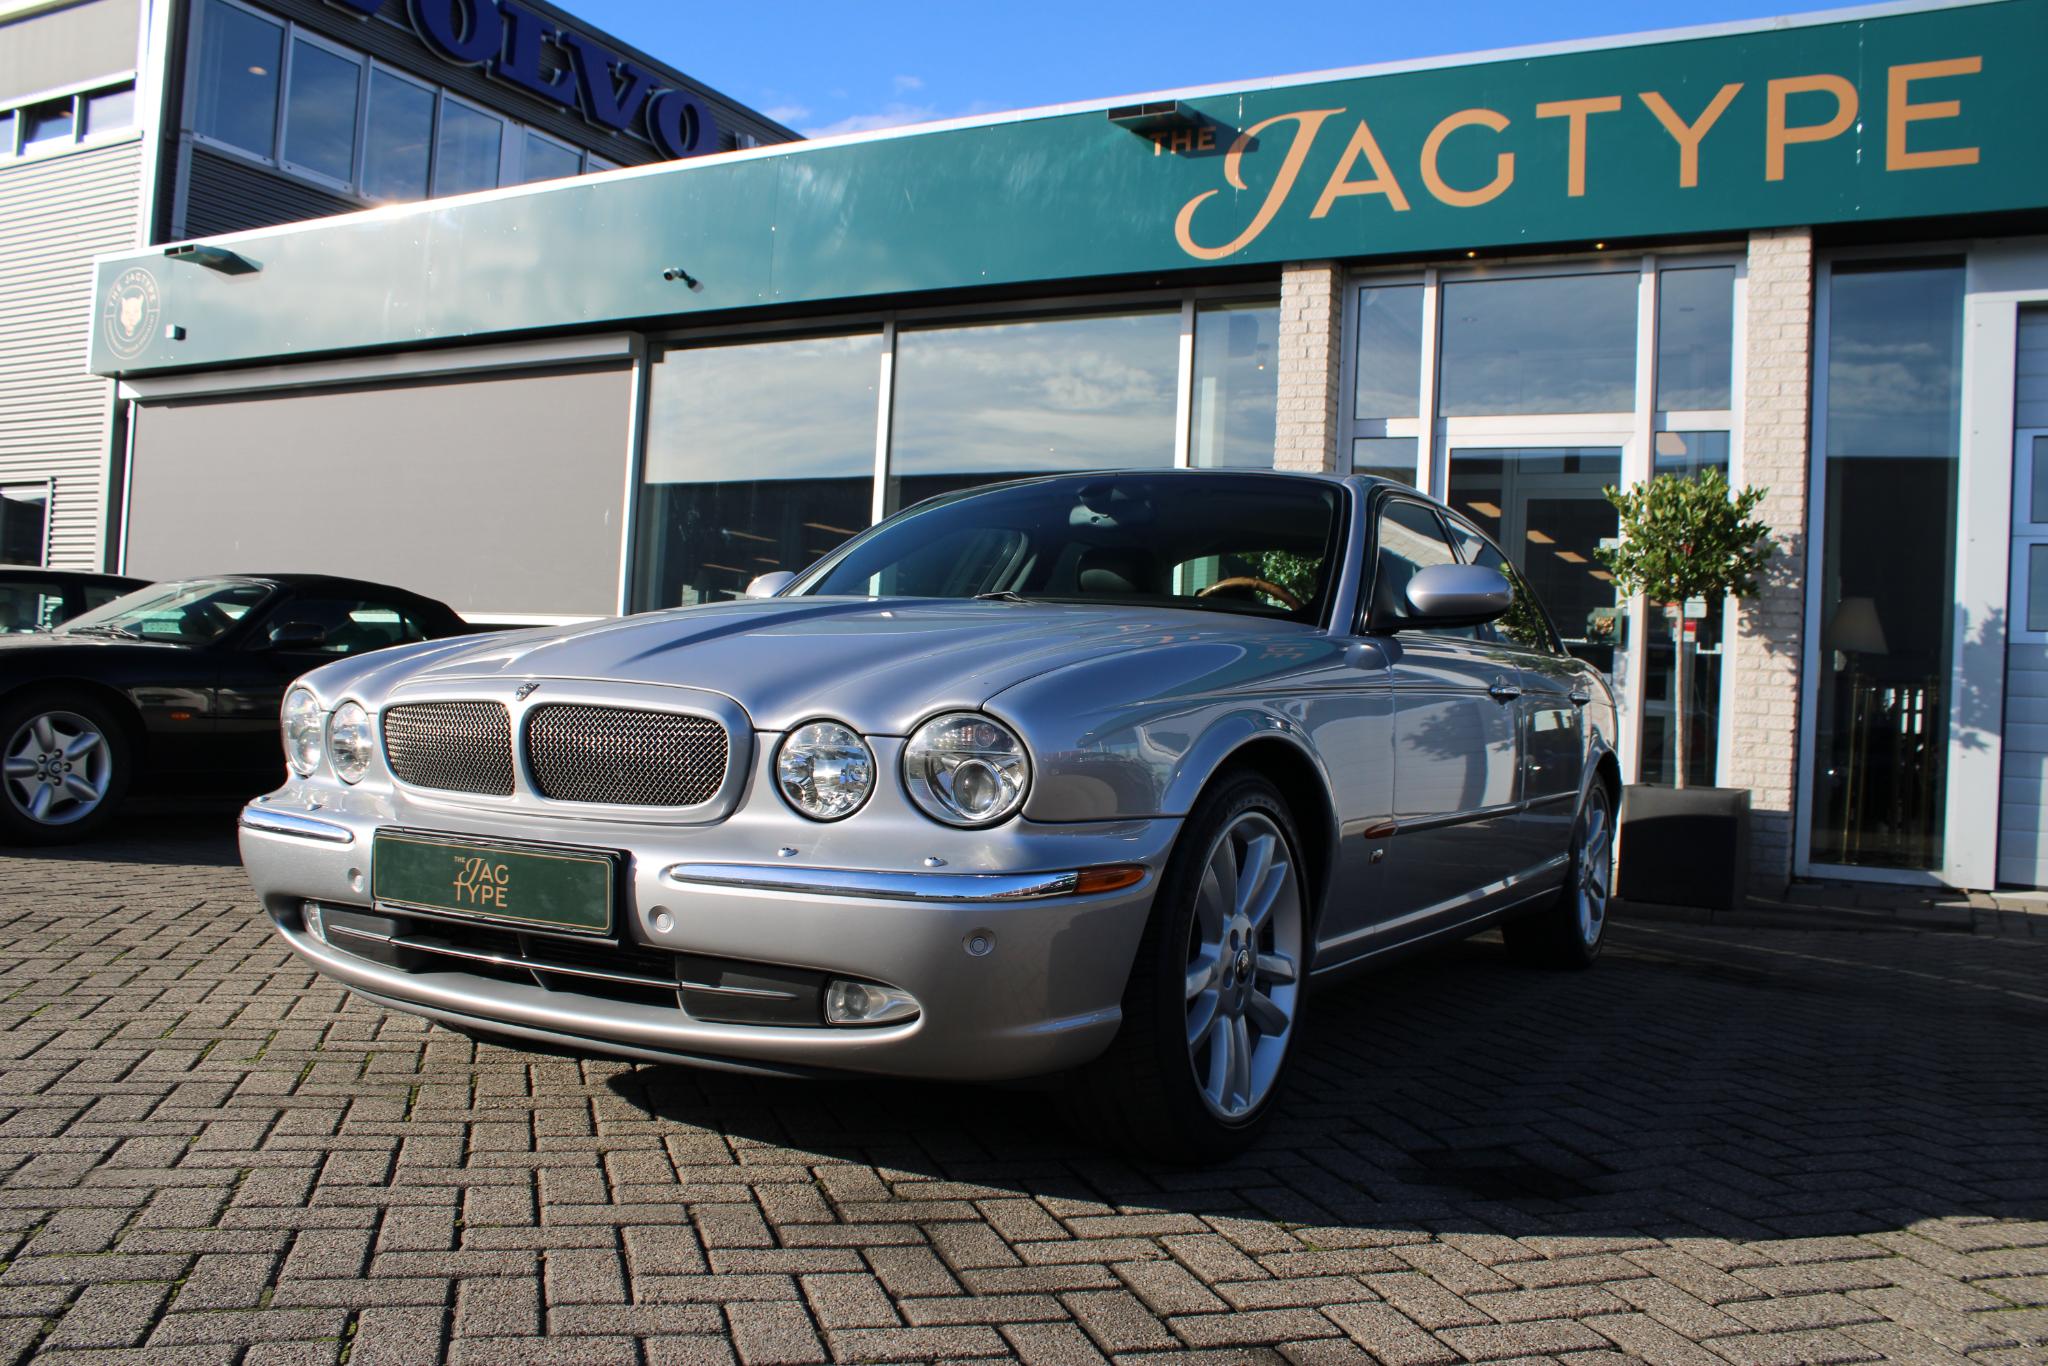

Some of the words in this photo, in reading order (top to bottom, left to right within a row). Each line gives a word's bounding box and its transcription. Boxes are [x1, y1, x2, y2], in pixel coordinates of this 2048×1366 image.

[324, 0, 720, 160] OLVO
[1151, 126, 1217, 156] THE
[1175, 56, 1982, 260] JAGTYPE
[458, 857, 509, 885] JAG
[453, 881, 508, 907] TYPE
